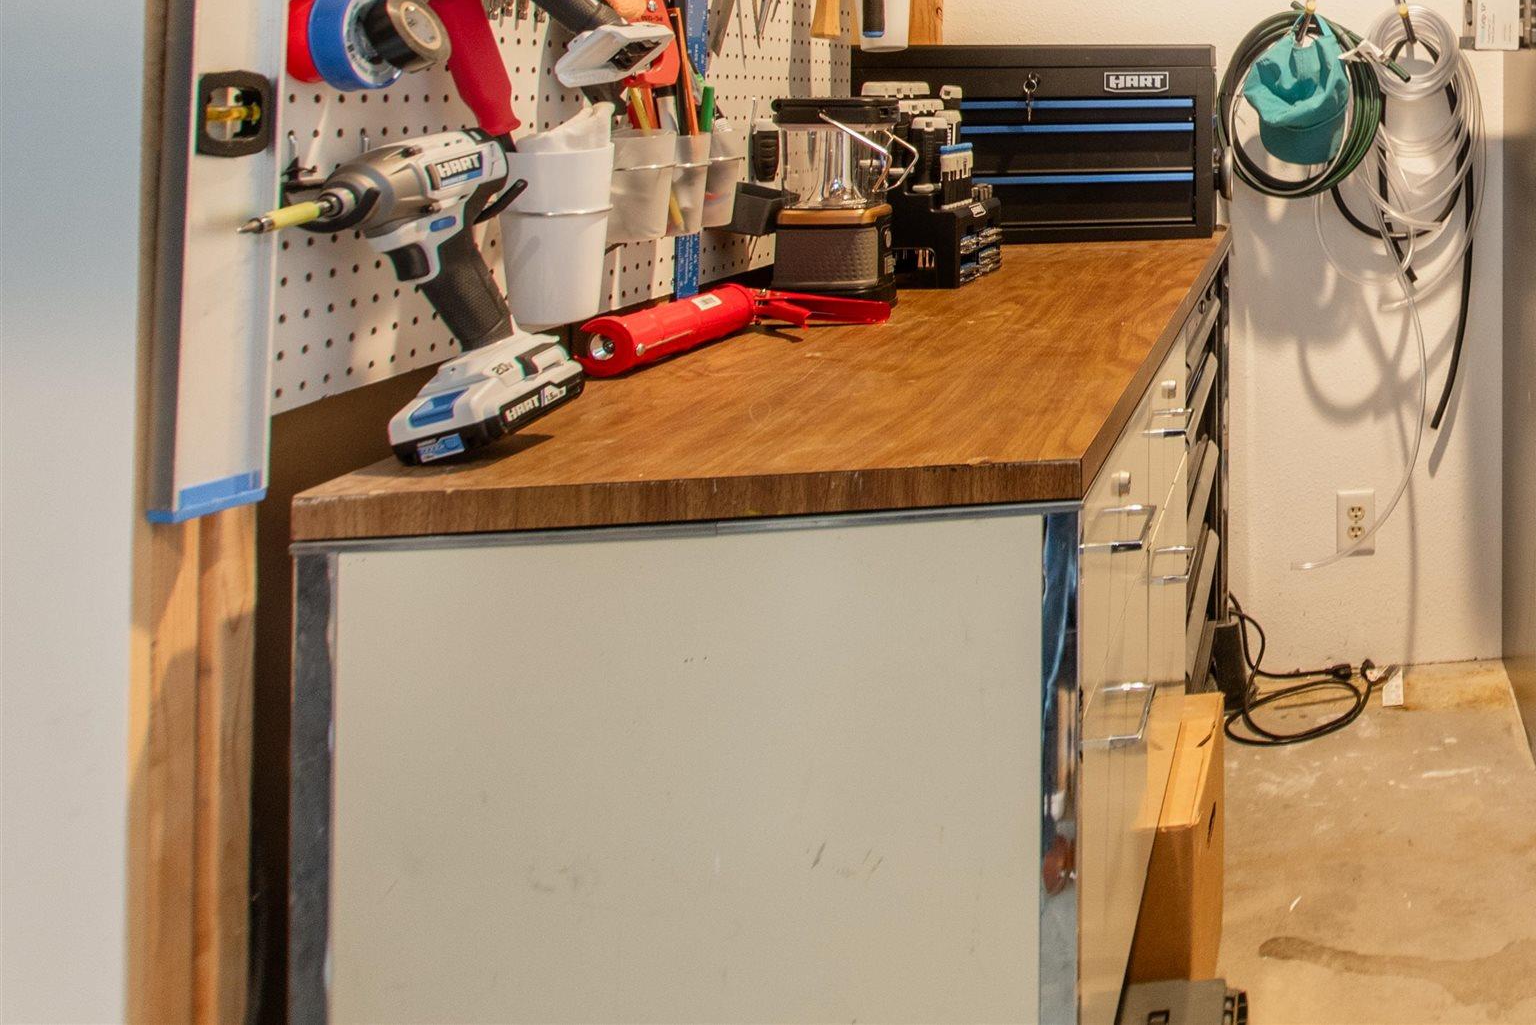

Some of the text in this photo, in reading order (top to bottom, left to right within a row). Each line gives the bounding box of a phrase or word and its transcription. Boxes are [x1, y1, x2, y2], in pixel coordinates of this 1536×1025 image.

[1109, 75, 1164, 89] HART
[436, 155, 480, 178] HART
[505, 395, 540, 422] HART
